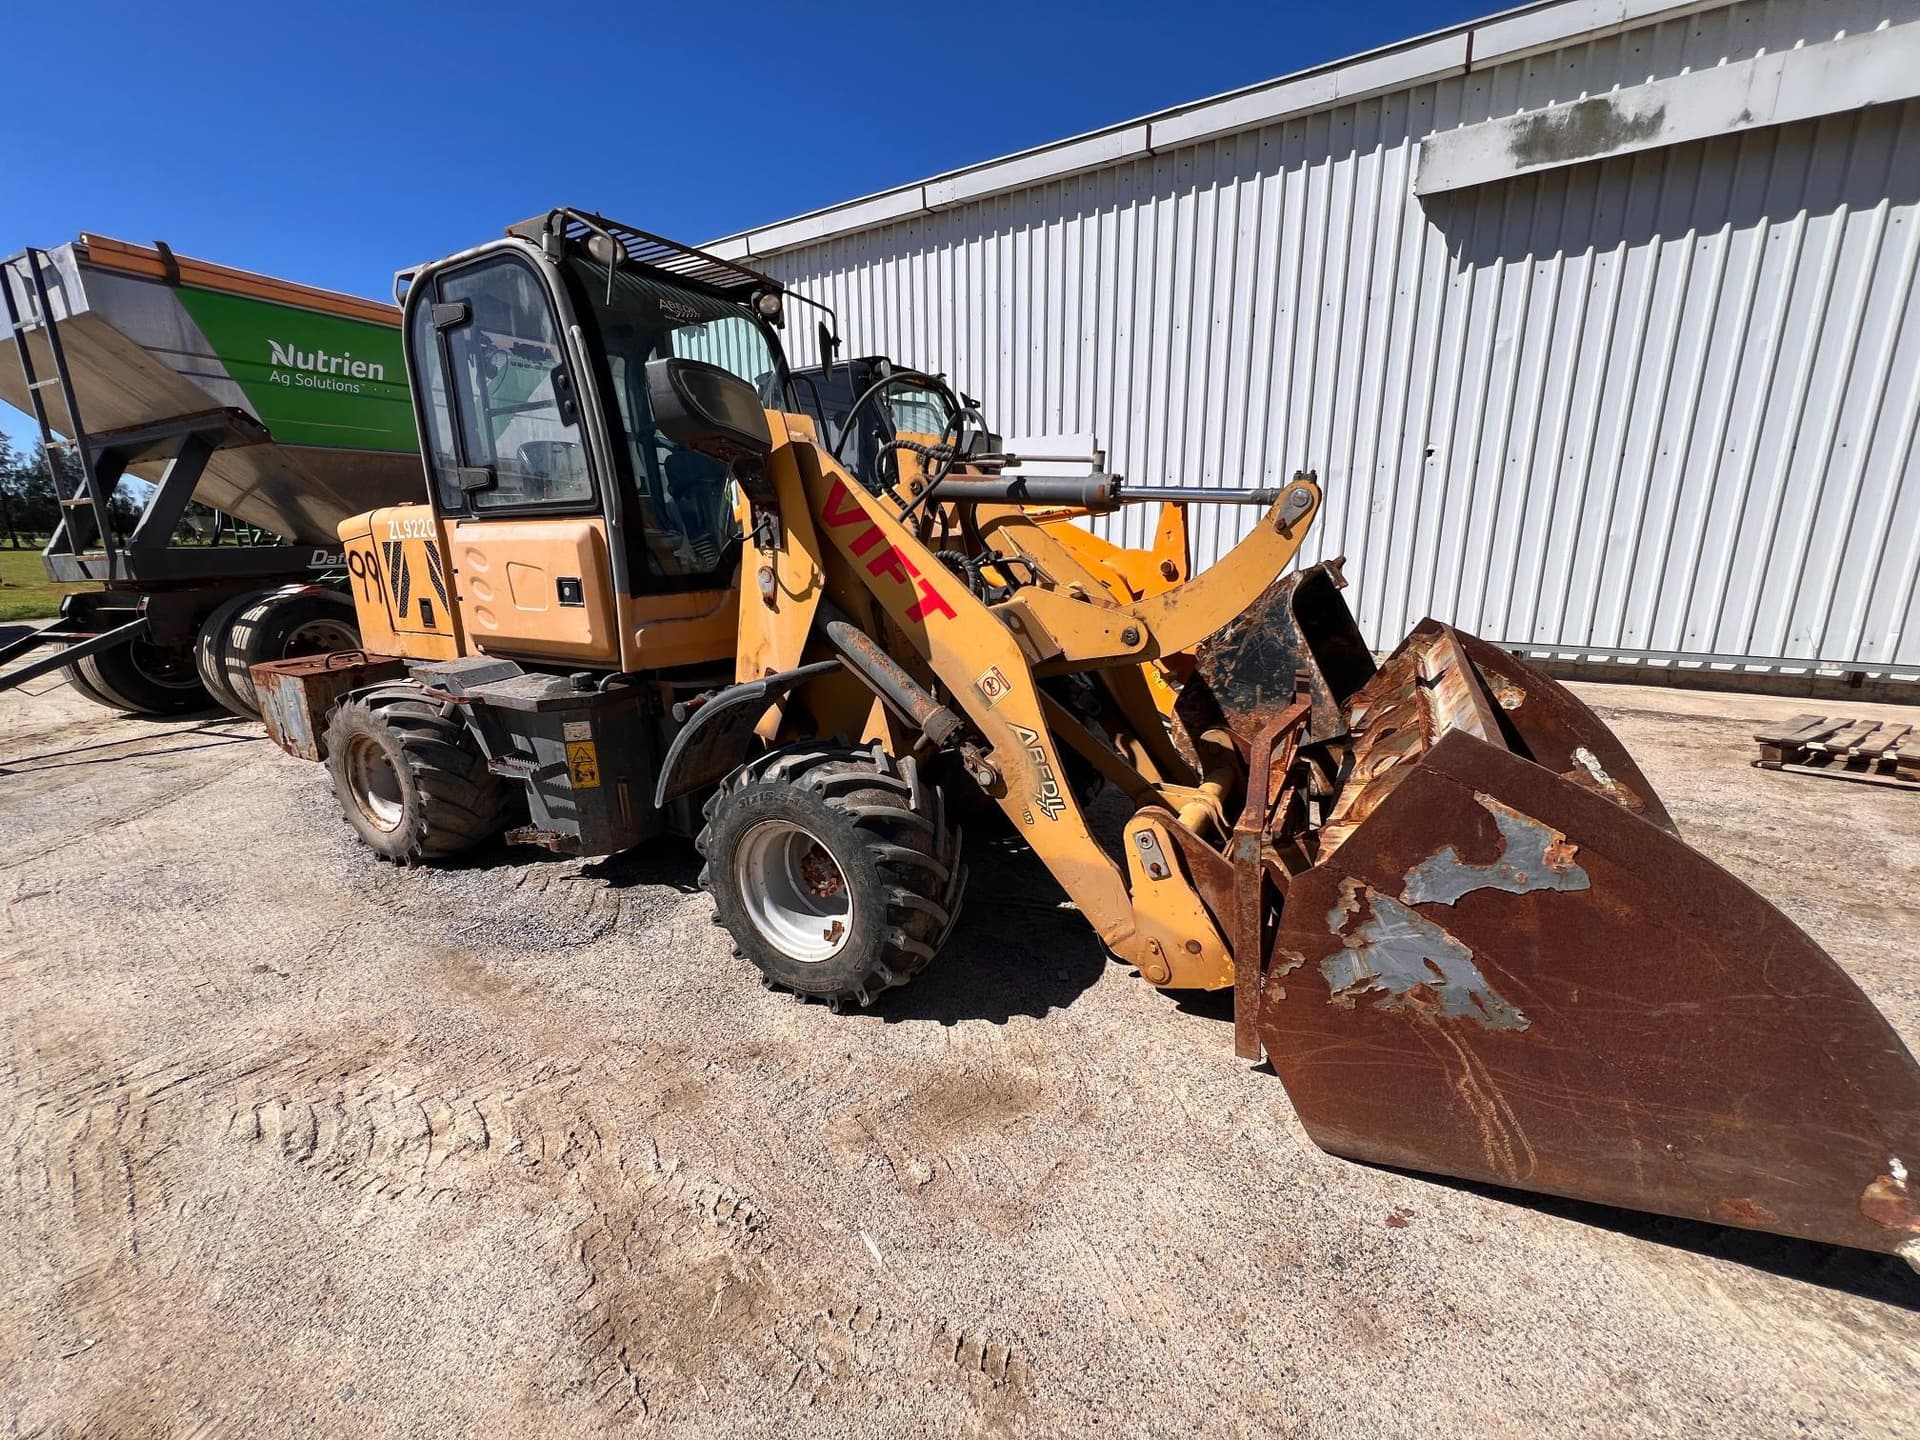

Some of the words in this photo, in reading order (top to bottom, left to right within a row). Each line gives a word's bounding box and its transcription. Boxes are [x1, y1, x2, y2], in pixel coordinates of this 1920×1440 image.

[267, 339, 384, 381] Nutrien
[269, 369, 290, 386] Ag
[295, 373, 360, 393] Solutions
[310, 549, 347, 566] Daf
[821, 478, 958, 625] VIFT
[348, 550, 383, 605] 99
